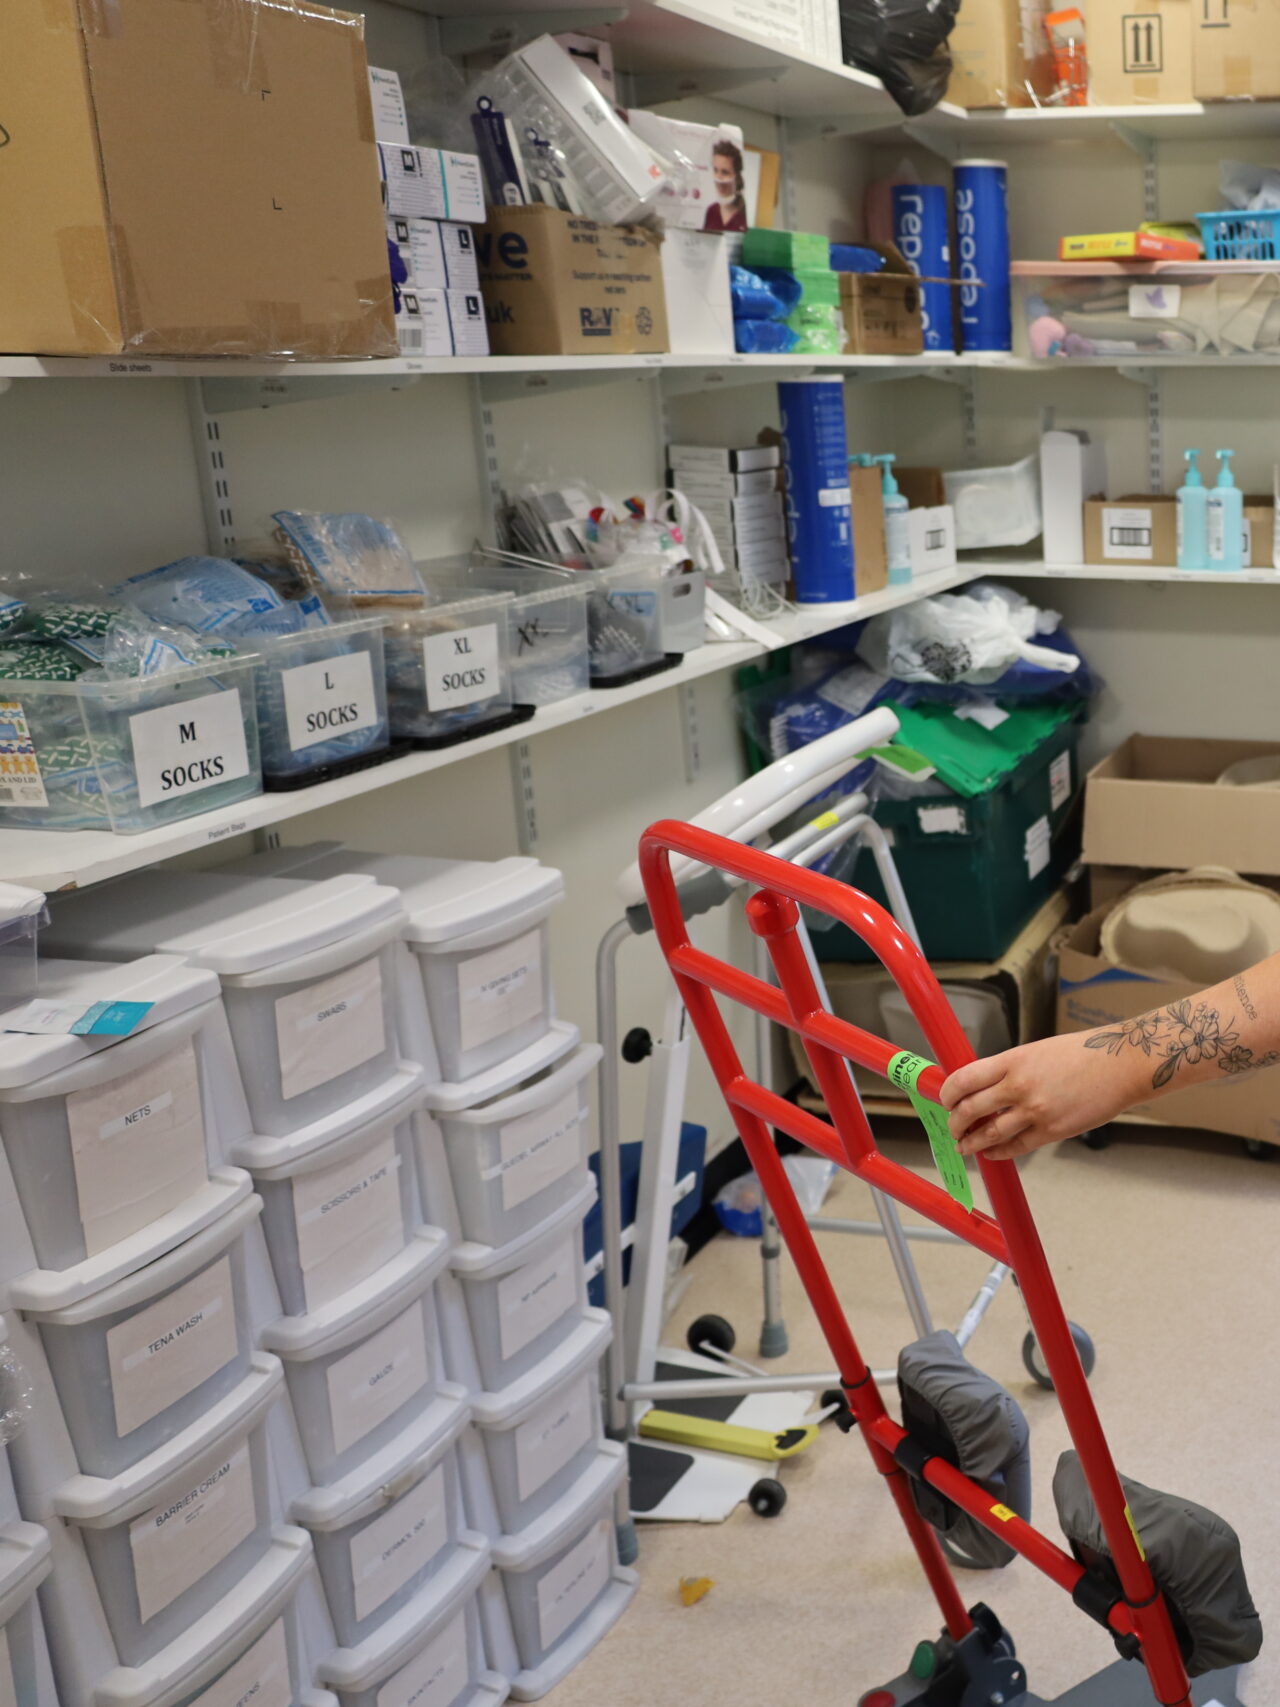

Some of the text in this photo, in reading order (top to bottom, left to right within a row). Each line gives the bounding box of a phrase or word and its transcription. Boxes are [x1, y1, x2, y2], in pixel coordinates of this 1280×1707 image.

[453, 636, 473, 656] XL
[323, 671, 335, 690] L
[441, 667, 486, 692] SOCKS
[306, 703, 360, 733] SOCKS
[179, 721, 198, 744] M
[160, 755, 226, 791] SOCKS
[124, 1104, 152, 1127] NETS
[148, 1311, 204, 1354] TENA WASH
[155, 1489, 199, 1527] BARRIER
[199, 1463, 231, 1494] CREAM
